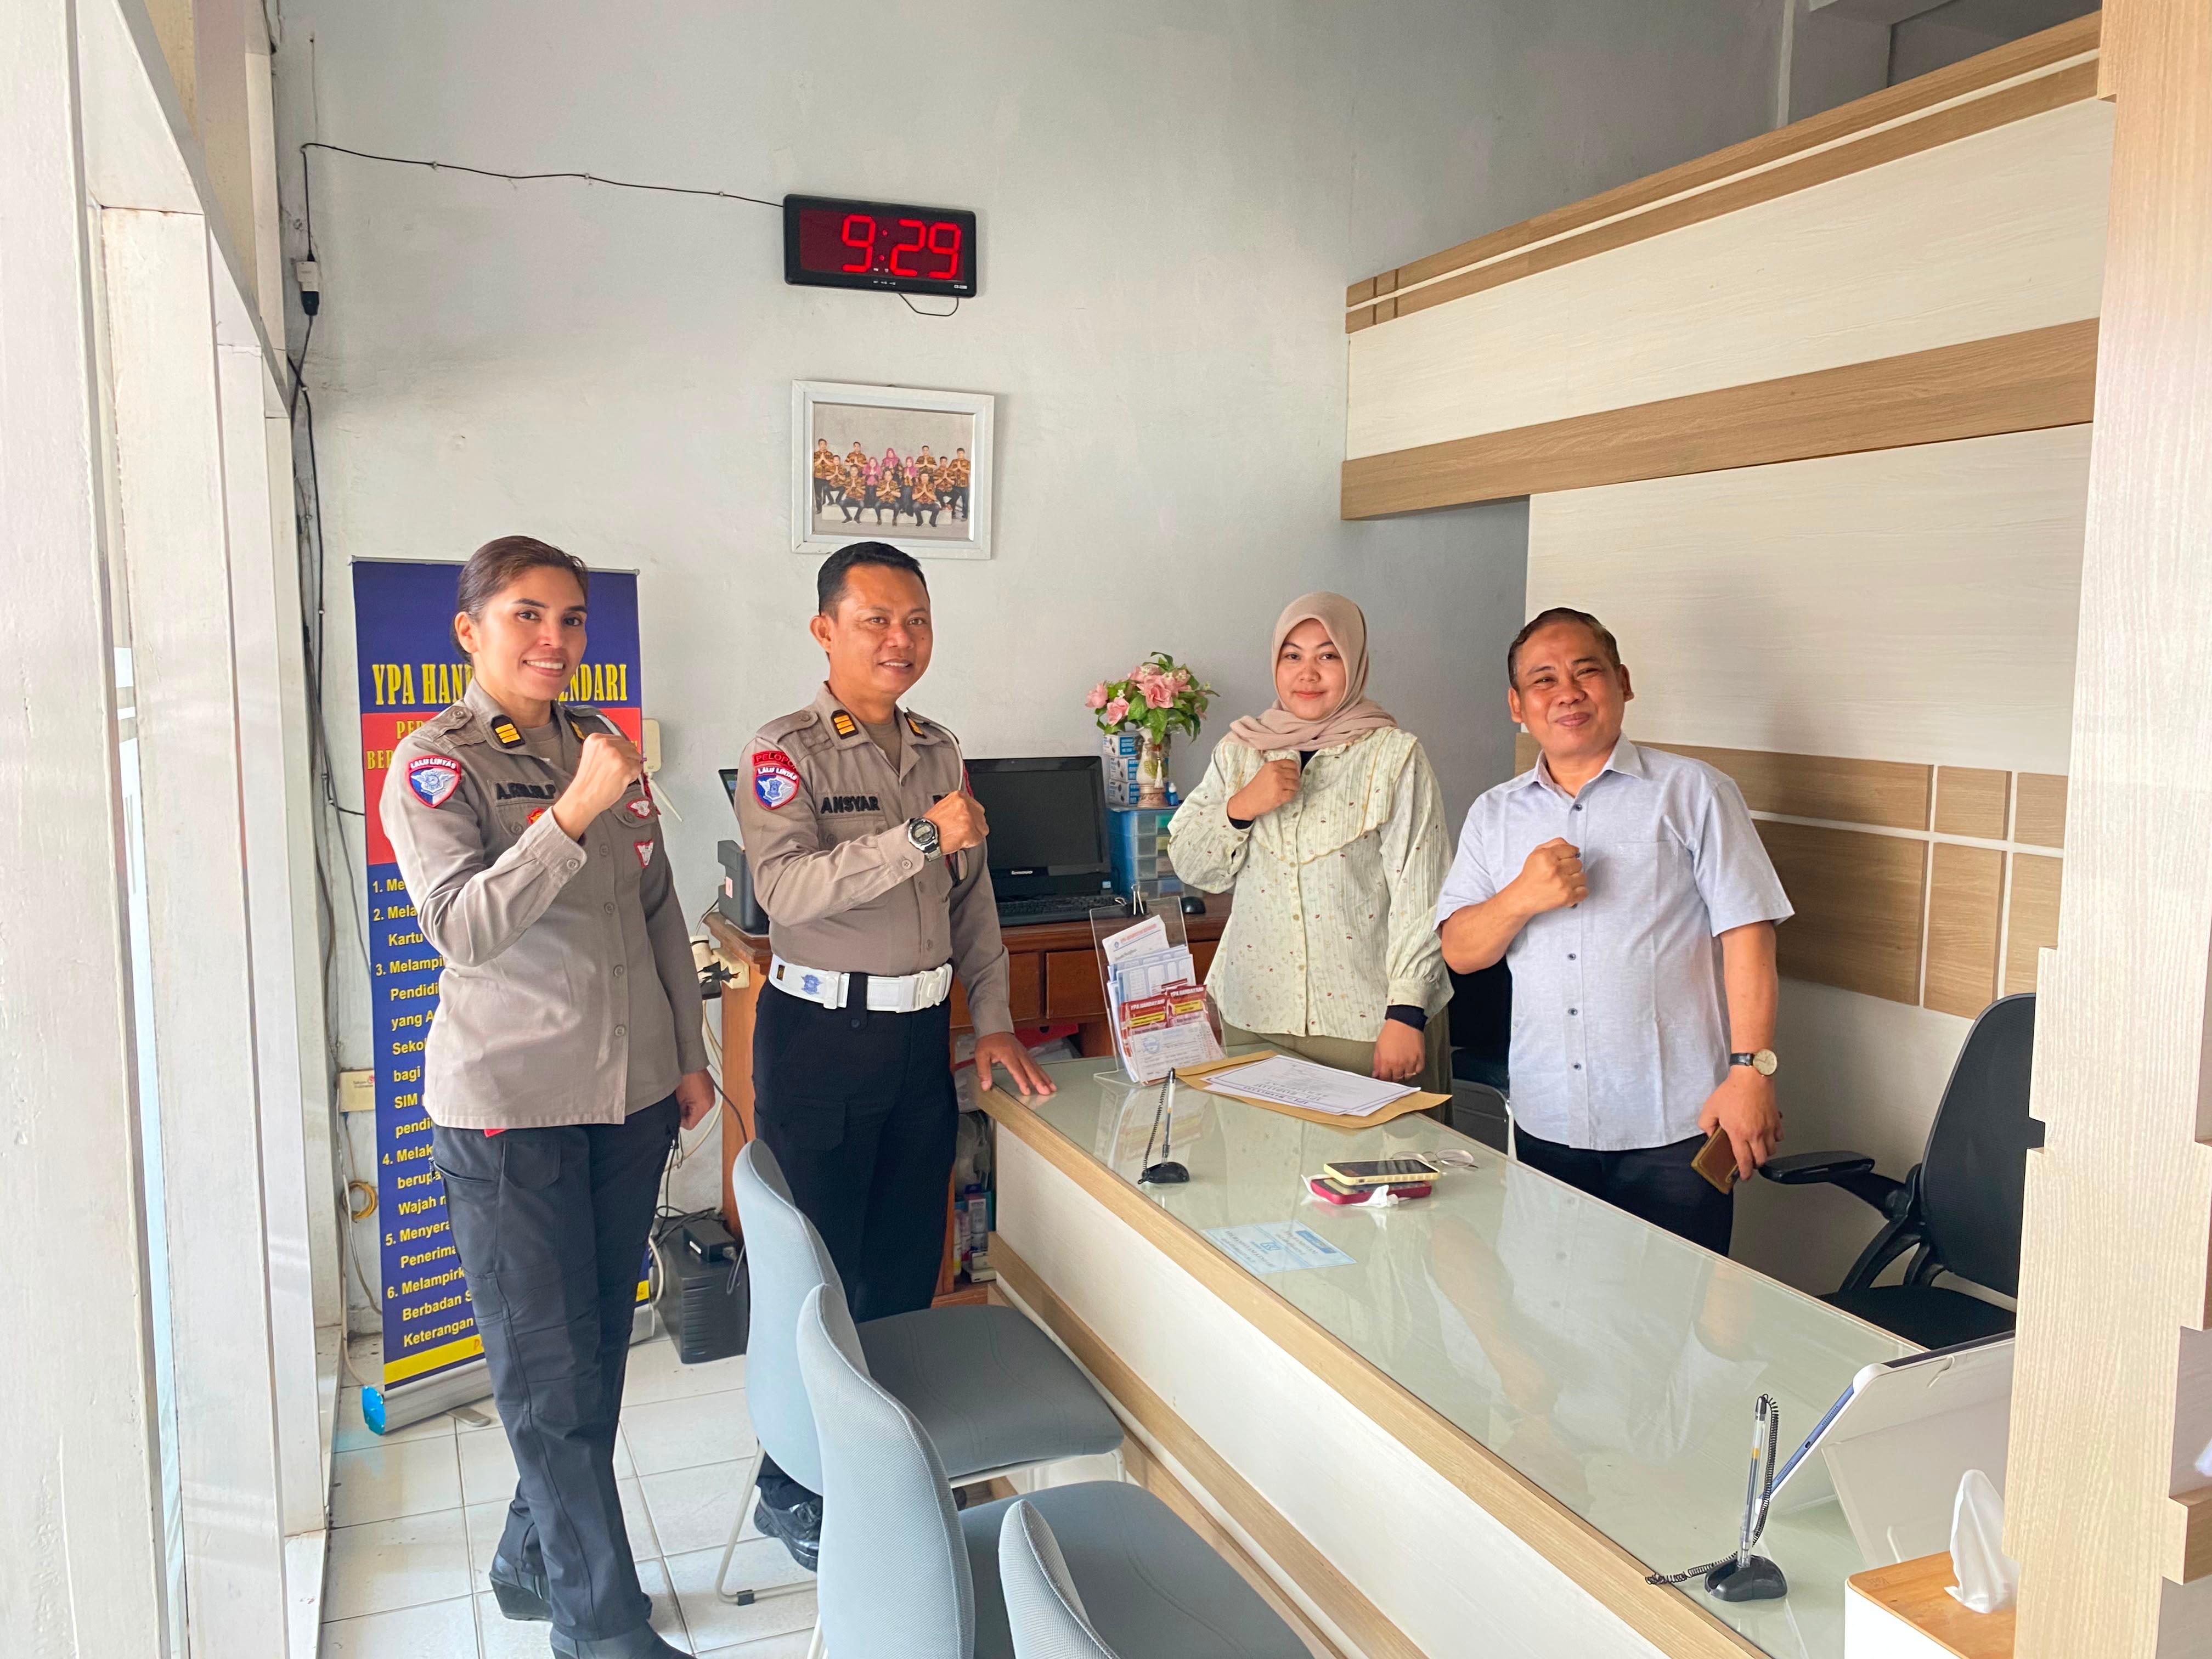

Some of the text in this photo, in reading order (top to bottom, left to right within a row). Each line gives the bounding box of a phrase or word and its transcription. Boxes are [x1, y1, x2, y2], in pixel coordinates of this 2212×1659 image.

[842, 214, 961, 279] 9:29
[372, 663, 415, 706] YPA
[410, 758, 456, 769] LALU LINTAS
[776, 768, 798, 780] LINTAS
[820, 795, 881, 814] ANSYAR
[373, 878, 405, 893] 1. Me
[374, 904, 417, 921] 2. Mela
[388, 932, 424, 947] Kartu
[375, 963, 386, 976] 3.
[390, 982, 439, 1001] Pendidi
[391, 1014, 422, 1031] yang
[393, 1065, 421, 1082] bagi
[394, 1093, 418, 1109] SIM
[382, 1153, 393, 1165] 4.
[397, 1171, 442, 1189] berupa
[398, 1196, 437, 1216] Wajah
[385, 1233, 397, 1246] 5.
[387, 1286, 398, 1299] 6.
[402, 1295, 462, 1322] Berbadan
[403, 1317, 474, 1348] Keterangan
